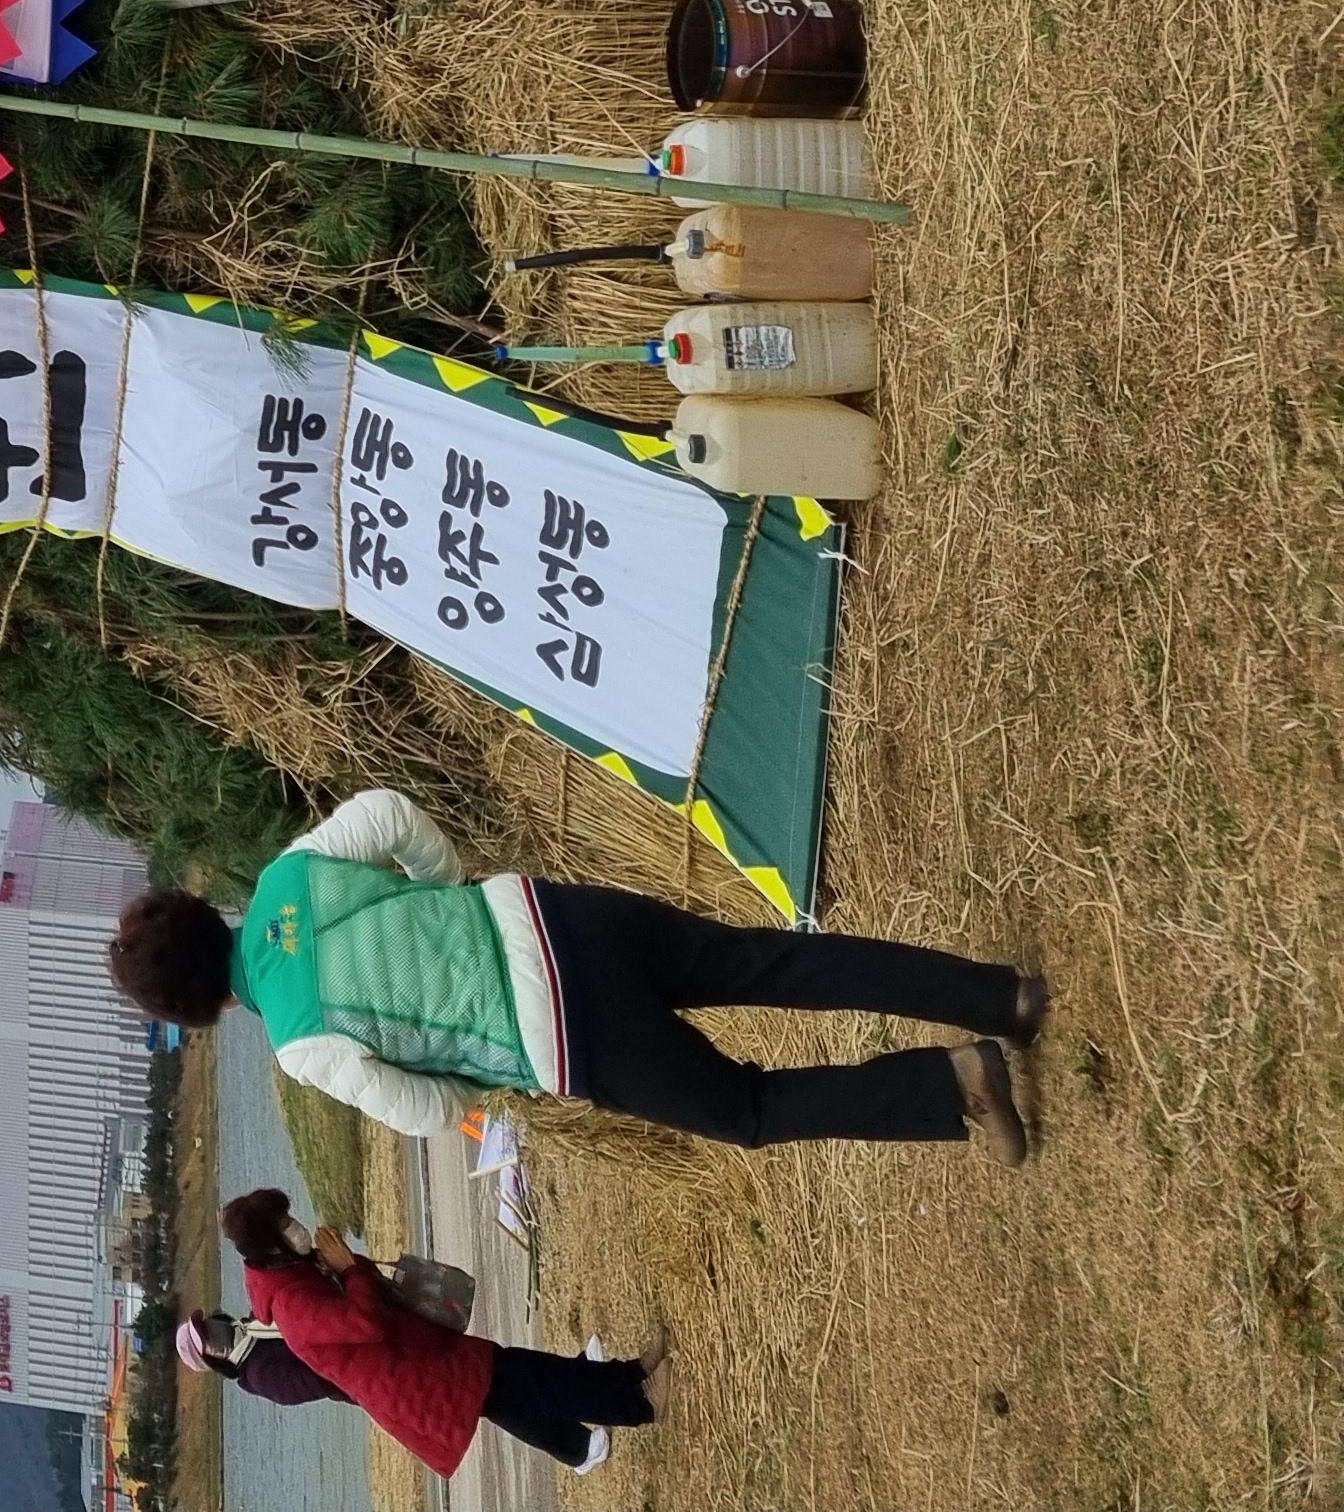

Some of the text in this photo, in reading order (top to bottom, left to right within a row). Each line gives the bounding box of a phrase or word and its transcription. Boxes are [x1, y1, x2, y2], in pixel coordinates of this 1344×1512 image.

[249, 394, 328, 567] 강서동
[345, 407, 415, 591] 중앙동
[436, 447, 511, 630] 양주동
[535, 488, 611, 686] 삼성동
